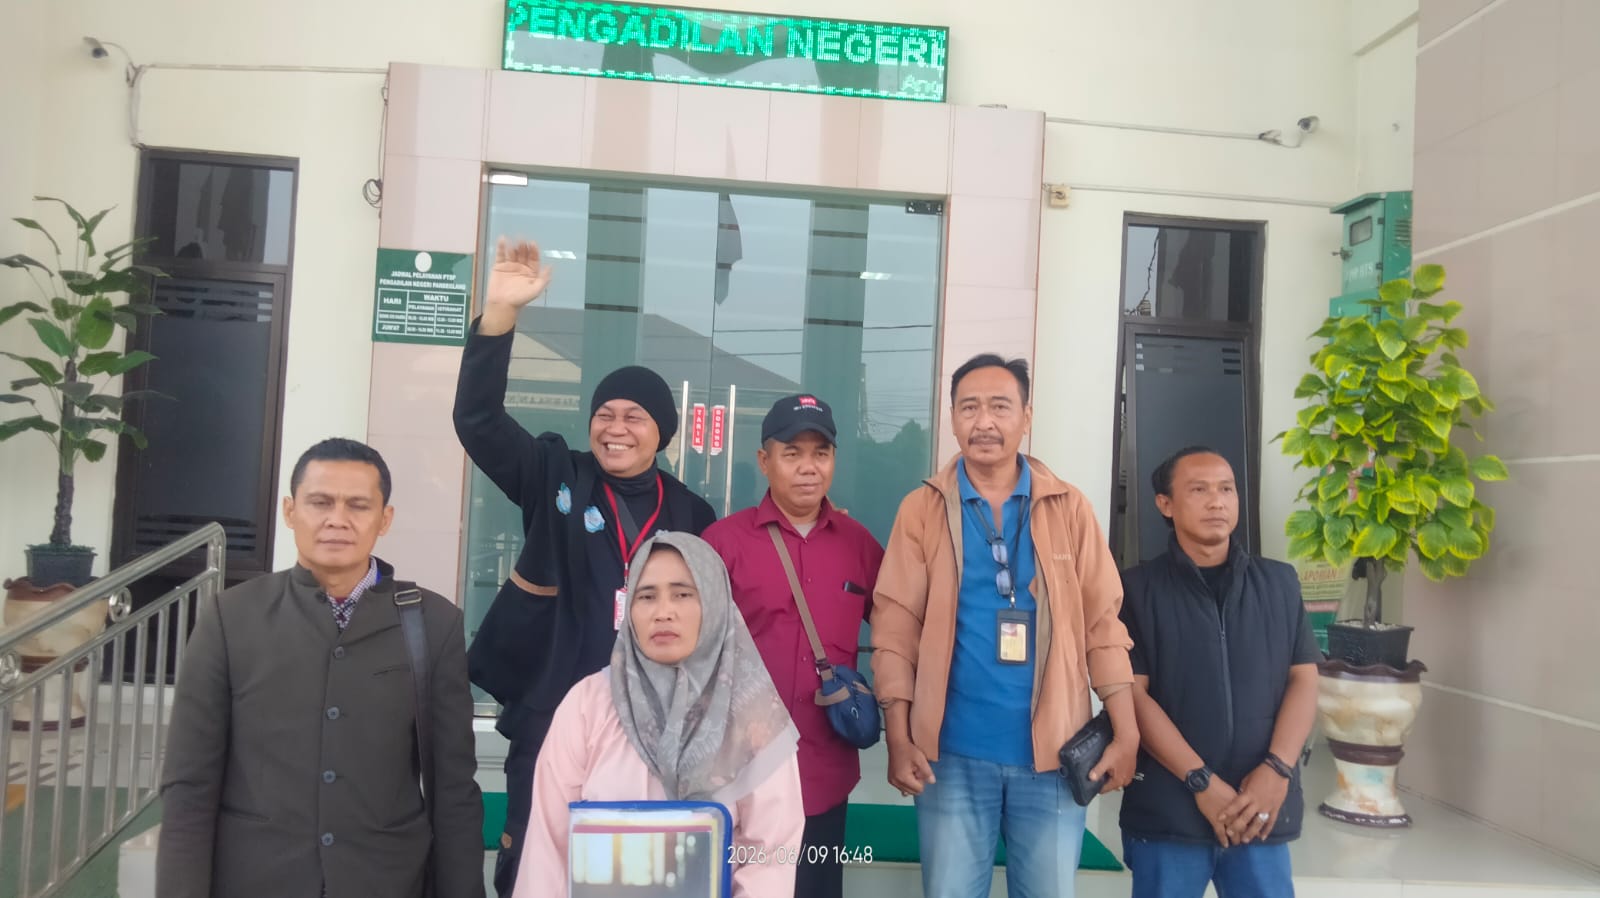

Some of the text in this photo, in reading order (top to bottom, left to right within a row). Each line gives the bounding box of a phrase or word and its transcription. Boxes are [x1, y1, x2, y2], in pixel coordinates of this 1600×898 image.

[391, 270, 412, 278] JADWAL
[379, 278, 412, 287] PENGADILAN
[413, 280, 432, 288] NEGERI
[383, 297, 402, 305] HARI
[423, 294, 449, 302] WAKTU
[714, 409, 722, 447] DORONG
